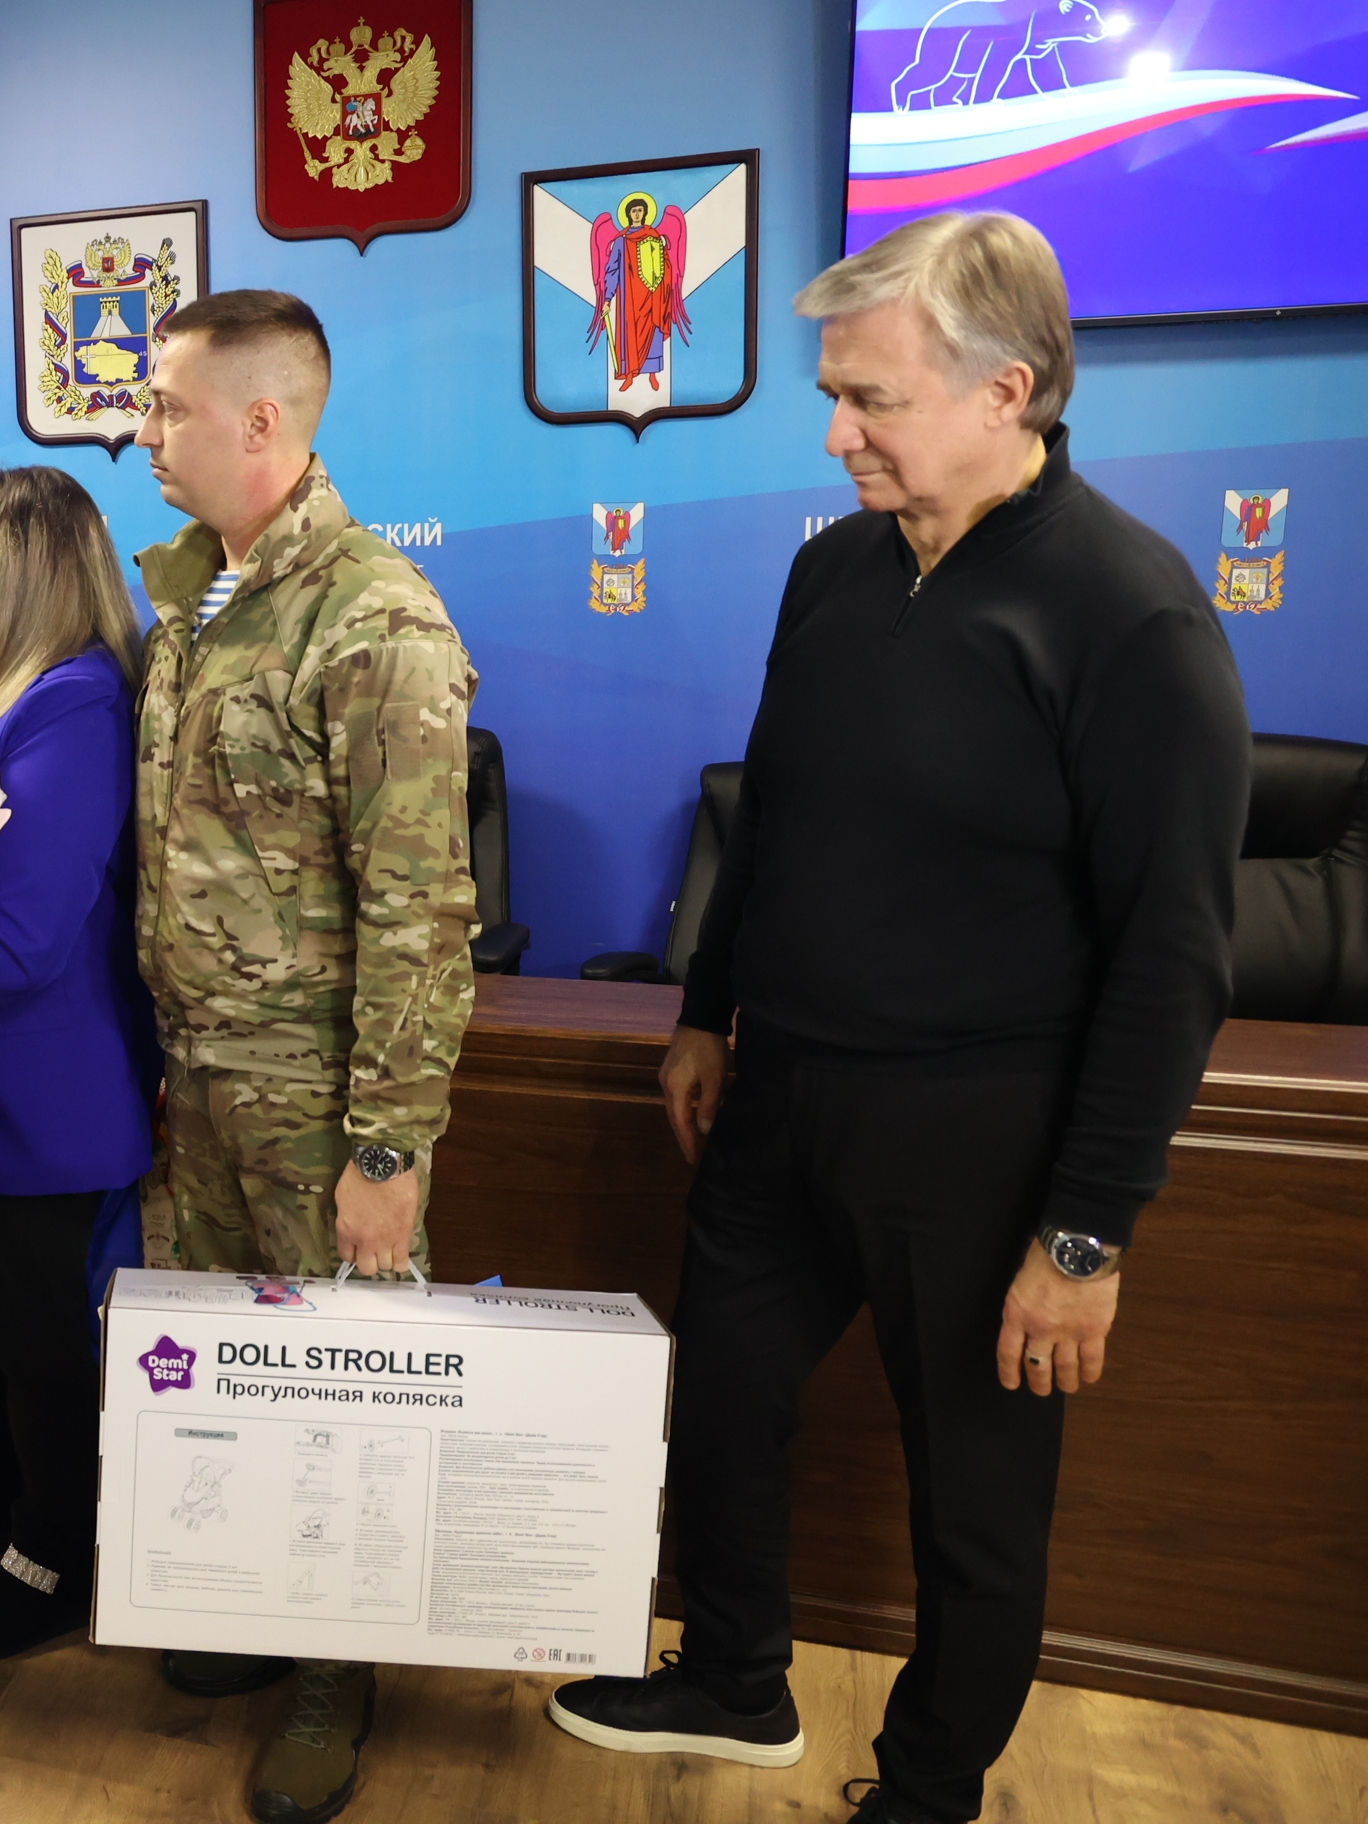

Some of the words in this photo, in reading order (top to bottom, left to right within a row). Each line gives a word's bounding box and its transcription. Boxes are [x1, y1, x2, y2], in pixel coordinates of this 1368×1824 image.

[473, 1296, 578, 1312] STROLLER
[582, 1306, 636, 1318] DOLL
[148, 1353, 189, 1370] Demi
[217, 1342, 297, 1368] DOLL
[305, 1346, 464, 1377] STROLLER
[153, 1368, 184, 1381] Star
[216, 1378, 364, 1403] Прогулочная
[372, 1390, 463, 1408] коляска
